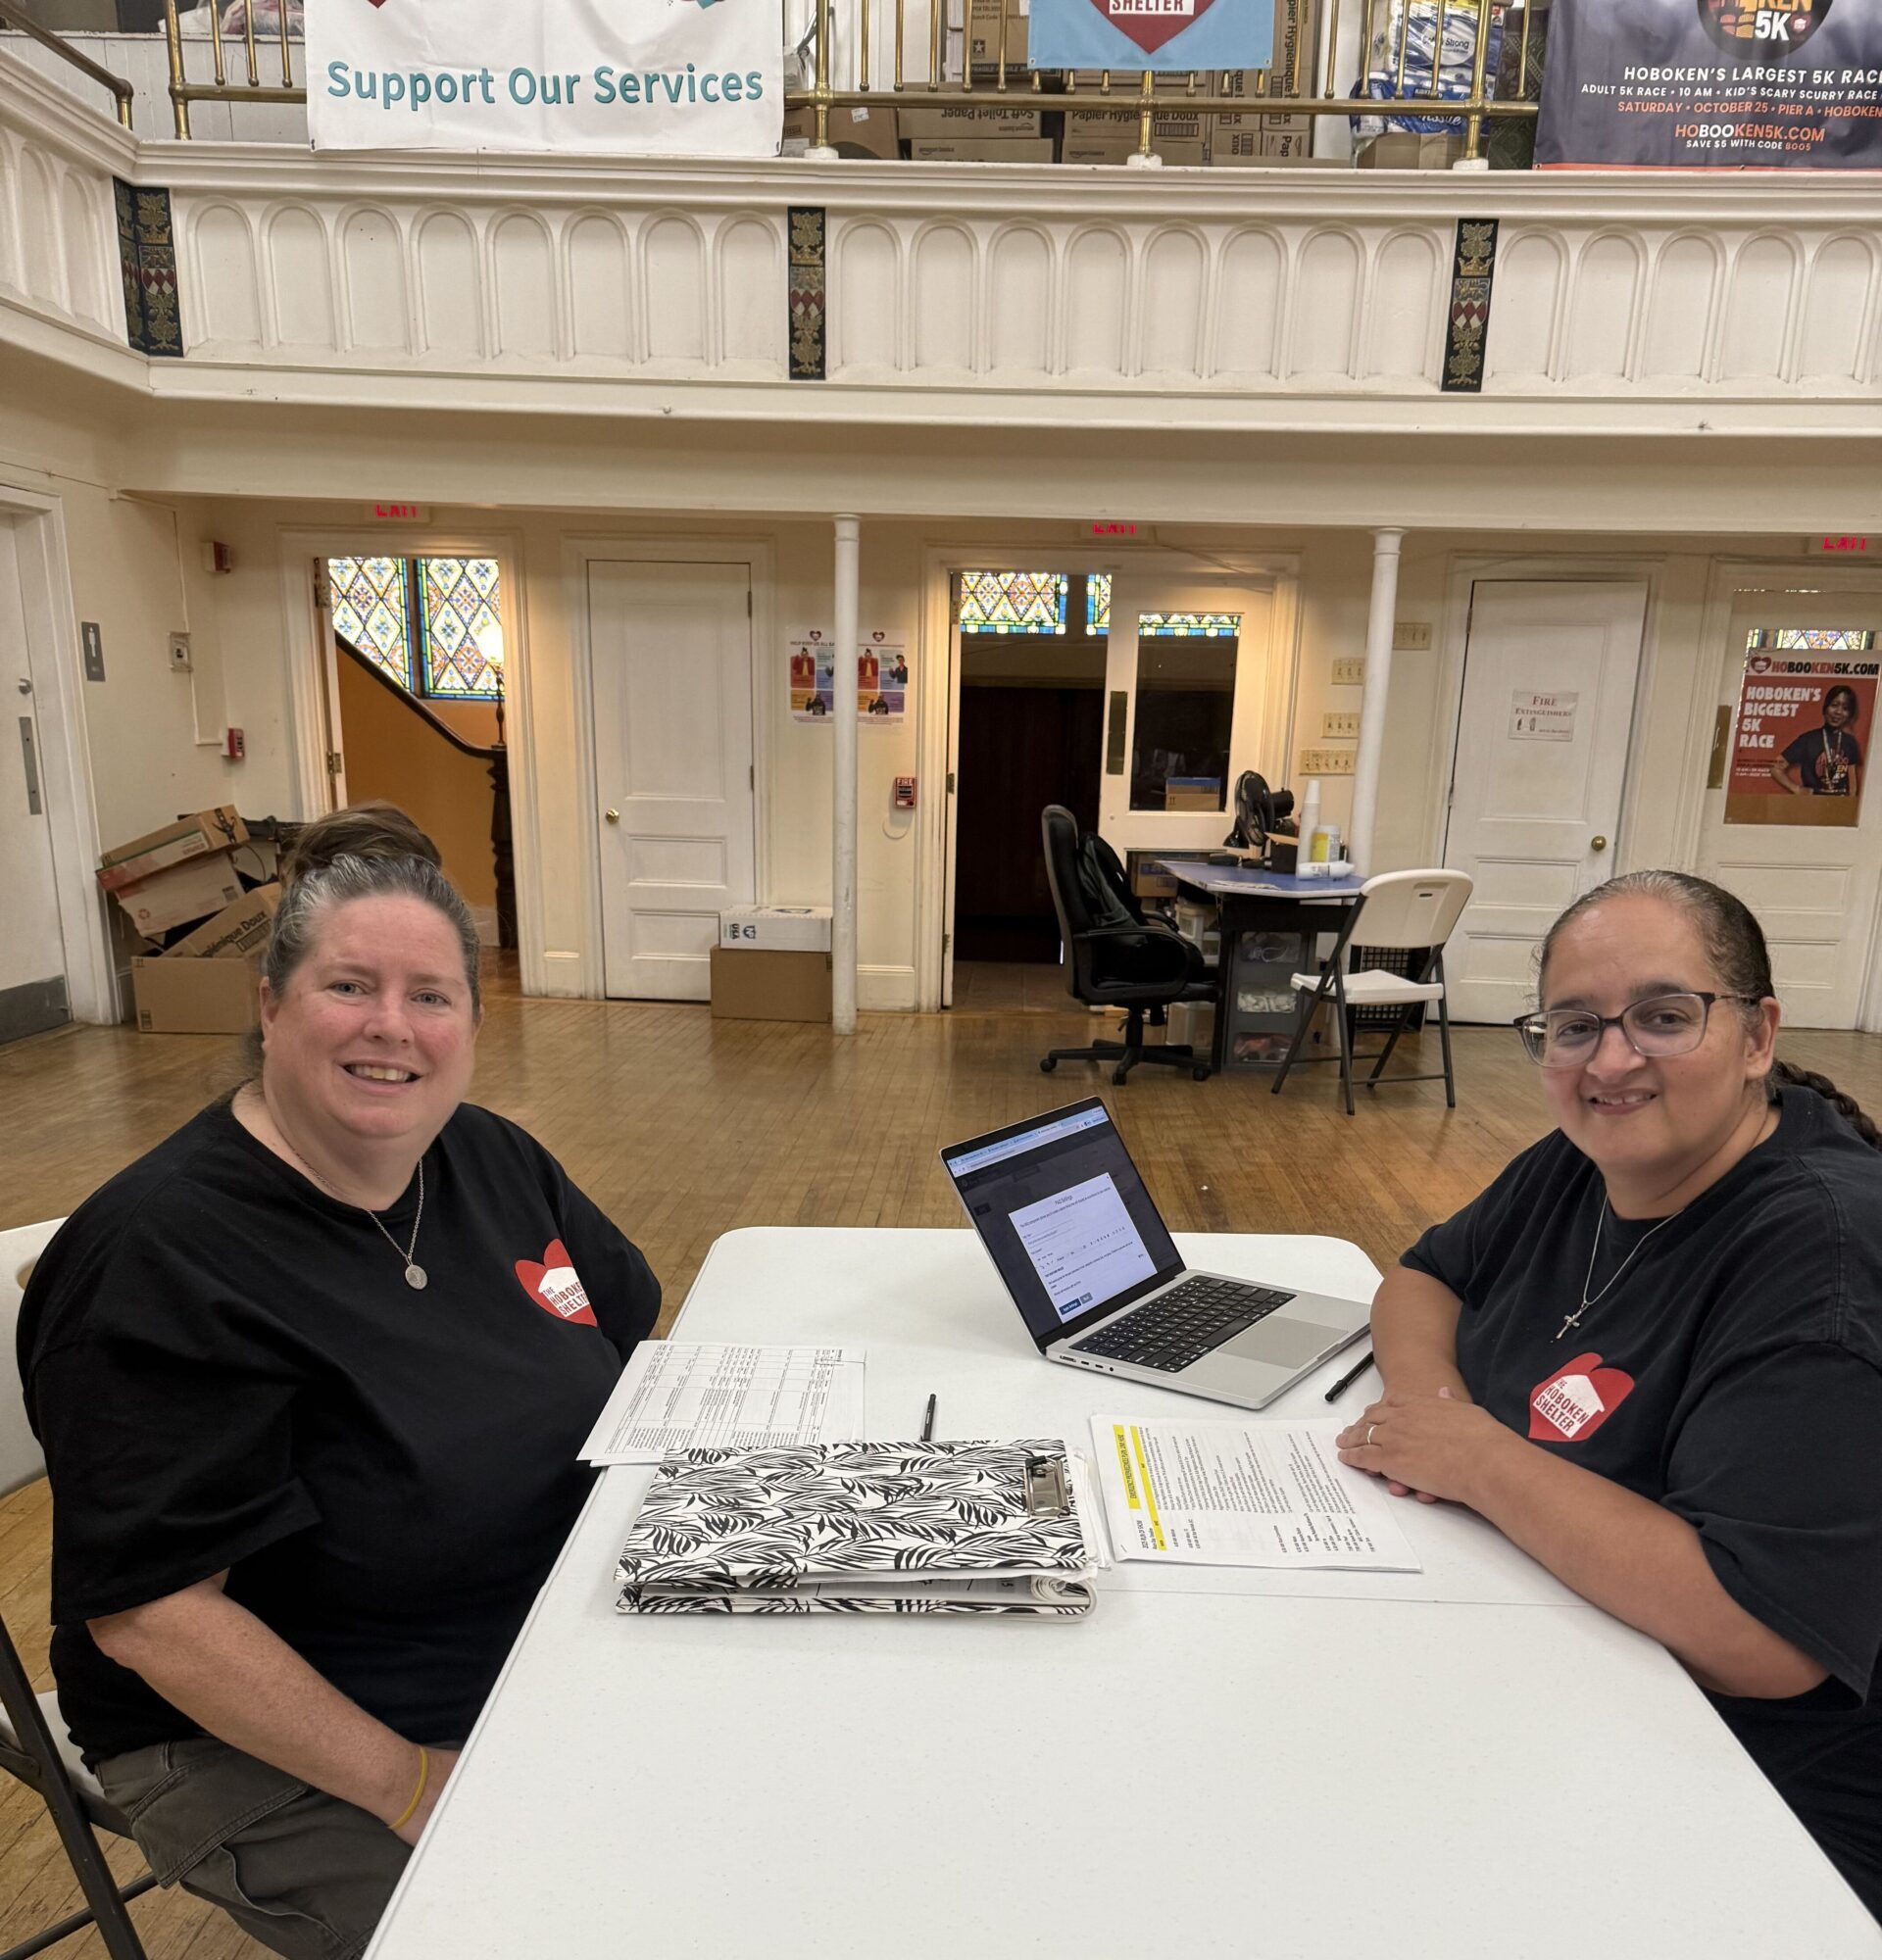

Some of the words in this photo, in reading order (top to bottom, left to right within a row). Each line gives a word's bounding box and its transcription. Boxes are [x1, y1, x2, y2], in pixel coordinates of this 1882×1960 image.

[1112, 0, 1184, 11] SHELTER
[1755, 10, 1792, 40] 5K
[1445, 38, 1469, 50] Strong
[1624, 67, 1726, 81] HOBOKEN'S
[1732, 67, 1807, 84] LARGEST
[1813, 70, 1835, 84] 5K
[327, 61, 495, 112] Support
[509, 67, 580, 105] Our
[594, 63, 763, 104] Services
[1581, 84, 1616, 95] ADULT
[1619, 85, 1633, 96] 5K
[1637, 86, 1666, 97] RACE
[1679, 87, 1691, 97] 10
[1694, 87, 1712, 97] AM
[1725, 86, 1758, 97] KID'S
[1760, 87, 1796, 99] SCARY
[1800, 90, 1845, 101] SCURRY
[1848, 90, 1877, 100] RACE
[977, 107, 1009, 121] Toilet
[1011, 107, 1034, 119] Soft
[1617, 101, 1683, 114] SATURDAY
[1694, 101, 1752, 114] OCTOBER
[1755, 102, 1768, 114] 25
[1778, 104, 1804, 116] PIER
[1806, 105, 1813, 116] A
[1171, 110, 1199, 122] Doux
[1675, 123, 1825, 142] HOBOOKEN5K.COM
[1231, 133, 1241, 156] oux
[1686, 139, 1711, 148] SAVE
[1714, 140, 1727, 149] $5
[1730, 139, 1755, 148] WITH
[1758, 141, 1782, 150] CODE
[1771, 661, 1880, 675] HOBOOKEN5K.COM
[1532, 695, 1558, 707] FIRE
[1747, 687, 1821, 701] HOBOKEN'S
[1745, 703, 1799, 716] BIGGEST
[1742, 718, 1761, 732] 5K
[1740, 734, 1774, 748] RACE
[542, 1286, 556, 1298] THE
[551, 1282, 582, 1305] HOBOKE
[1557, 1378, 1567, 1389] THE
[1545, 1385, 1589, 1424] HOBOKEN
[1535, 1395, 1575, 1432] SHELTER
